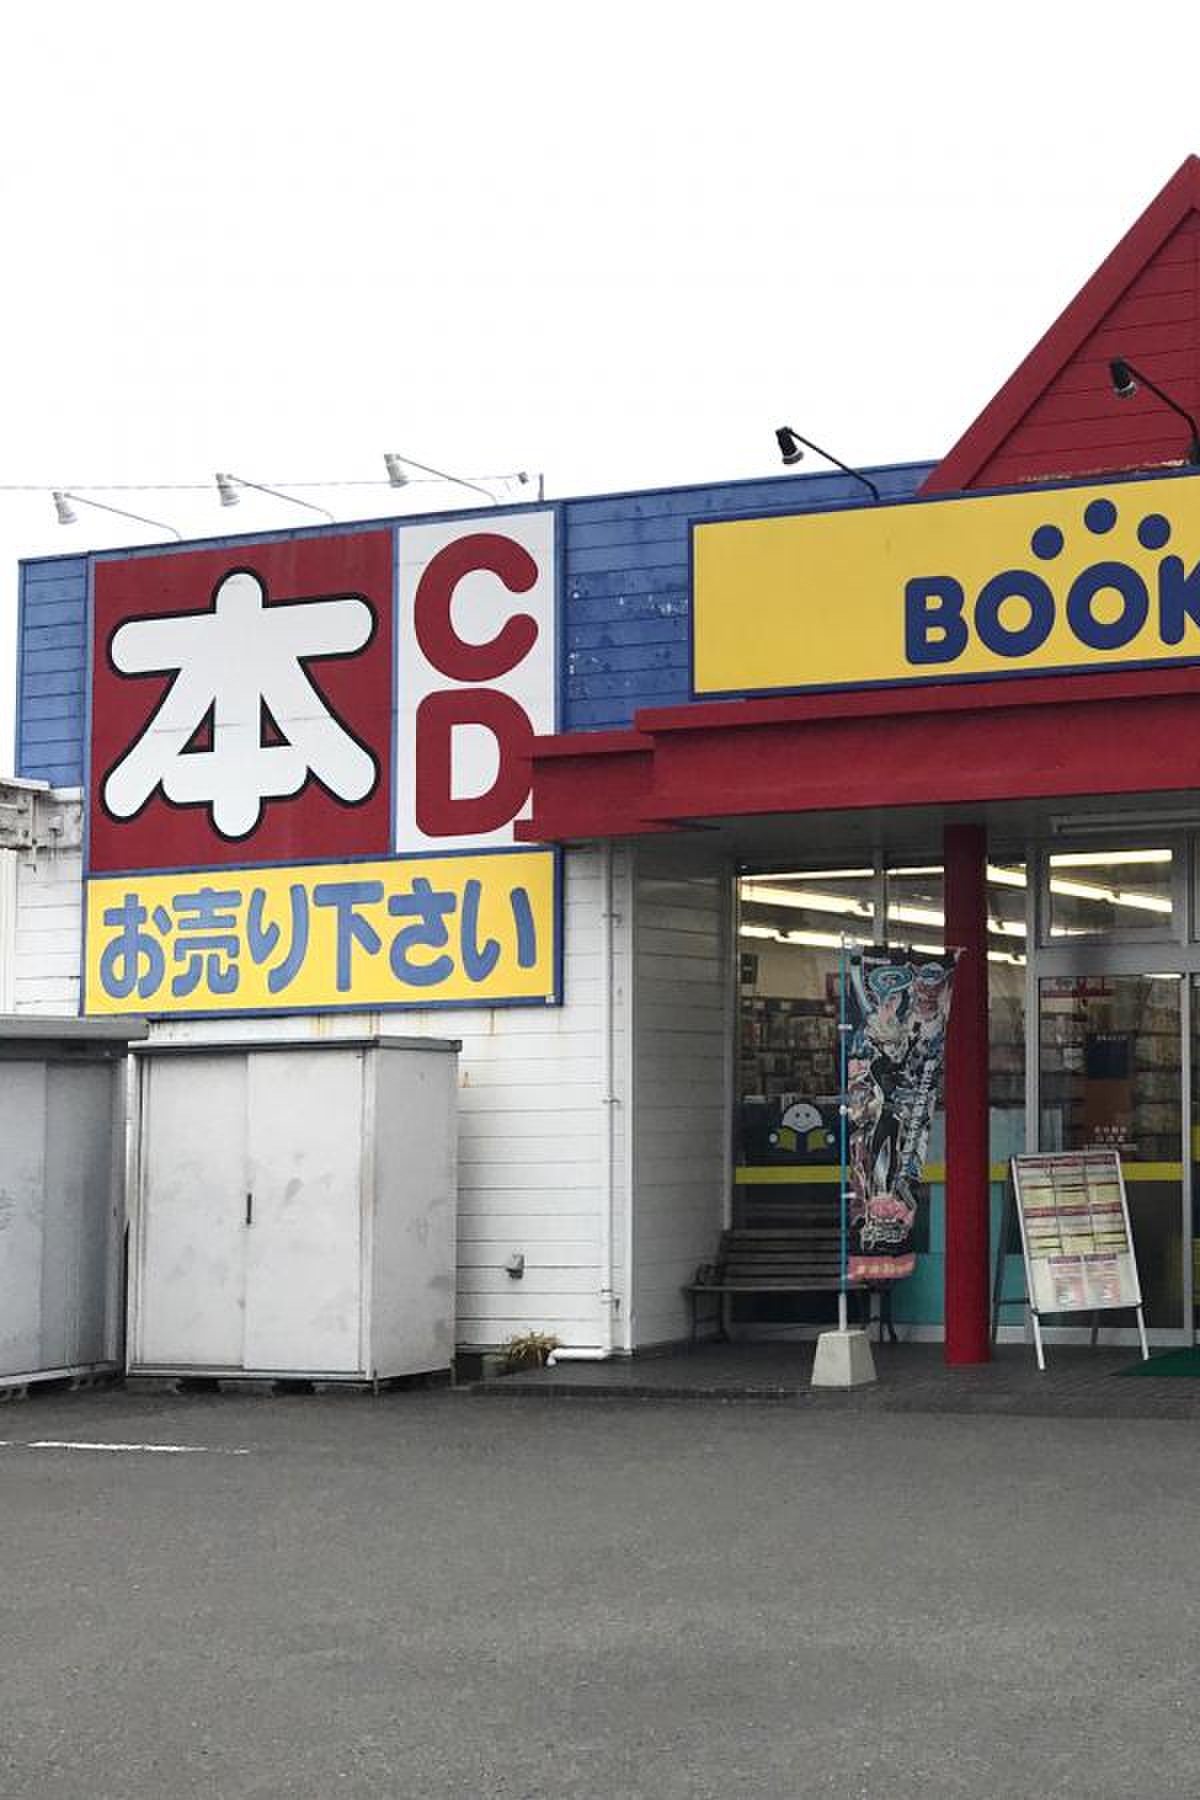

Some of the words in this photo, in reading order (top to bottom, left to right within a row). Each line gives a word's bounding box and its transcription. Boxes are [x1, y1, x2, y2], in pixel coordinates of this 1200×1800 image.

[103, 566, 376, 838] 本
[99, 877, 536, 998] お売り下さい
